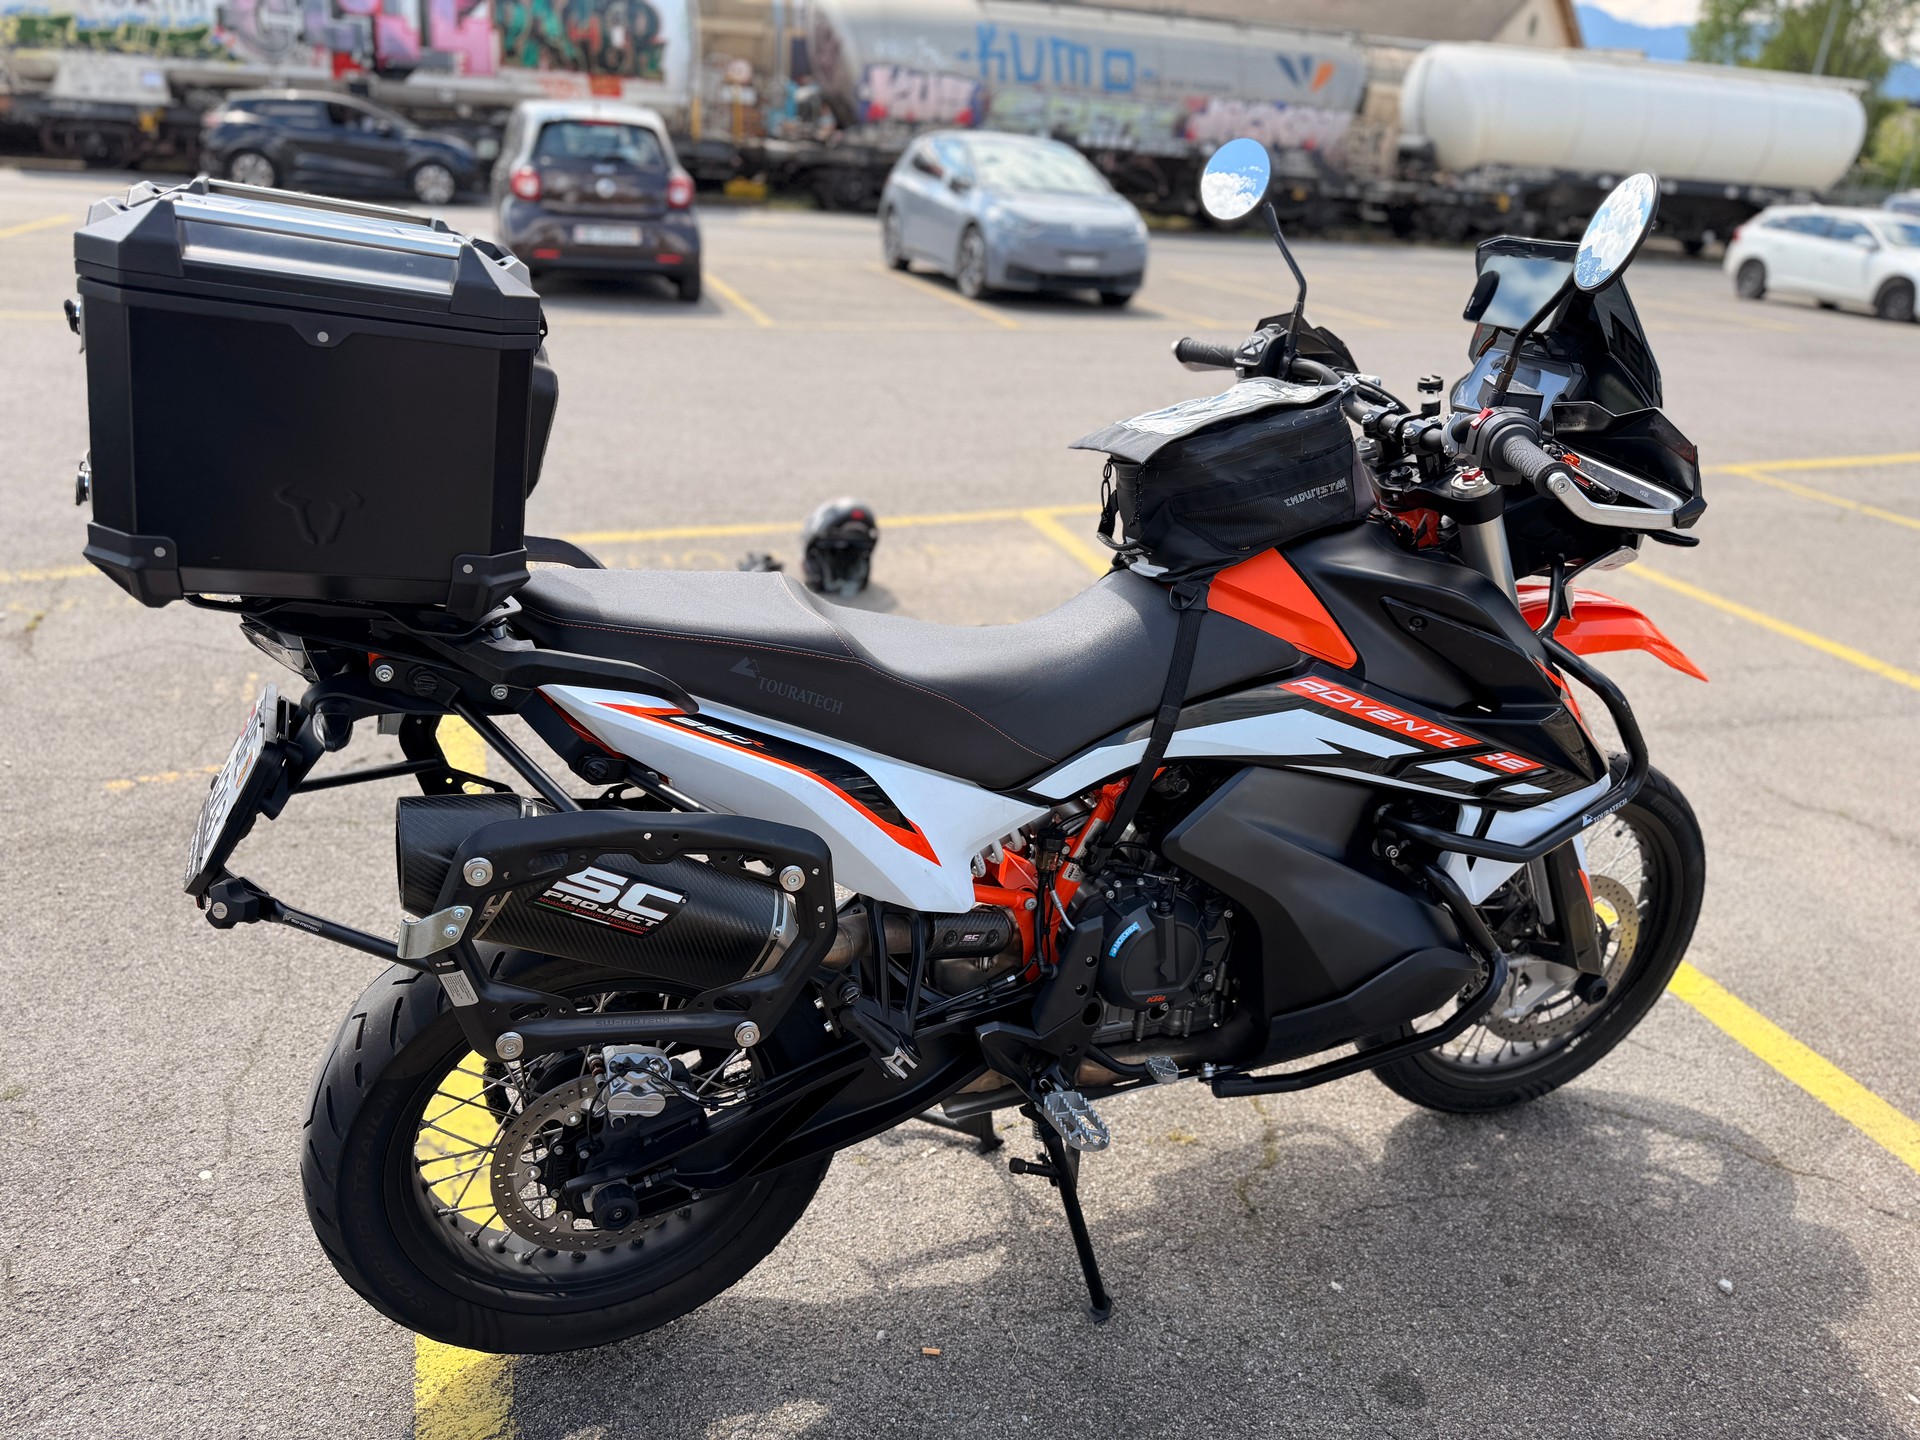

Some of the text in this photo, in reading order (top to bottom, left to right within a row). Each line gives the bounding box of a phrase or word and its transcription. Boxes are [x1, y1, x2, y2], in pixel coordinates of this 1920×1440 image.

[759, 676, 844, 715] TOURATECH
[1593, 798, 1628, 822] TOURATECH
[542, 890, 659, 927] PROJECT
[552, 866, 684, 921] SC
[537, 897, 650, 932] ADVANCED EXHAUST TECHNOLOGY
[962, 934, 980, 942] SC
[1114, 922, 1139, 948] MOTOREX
